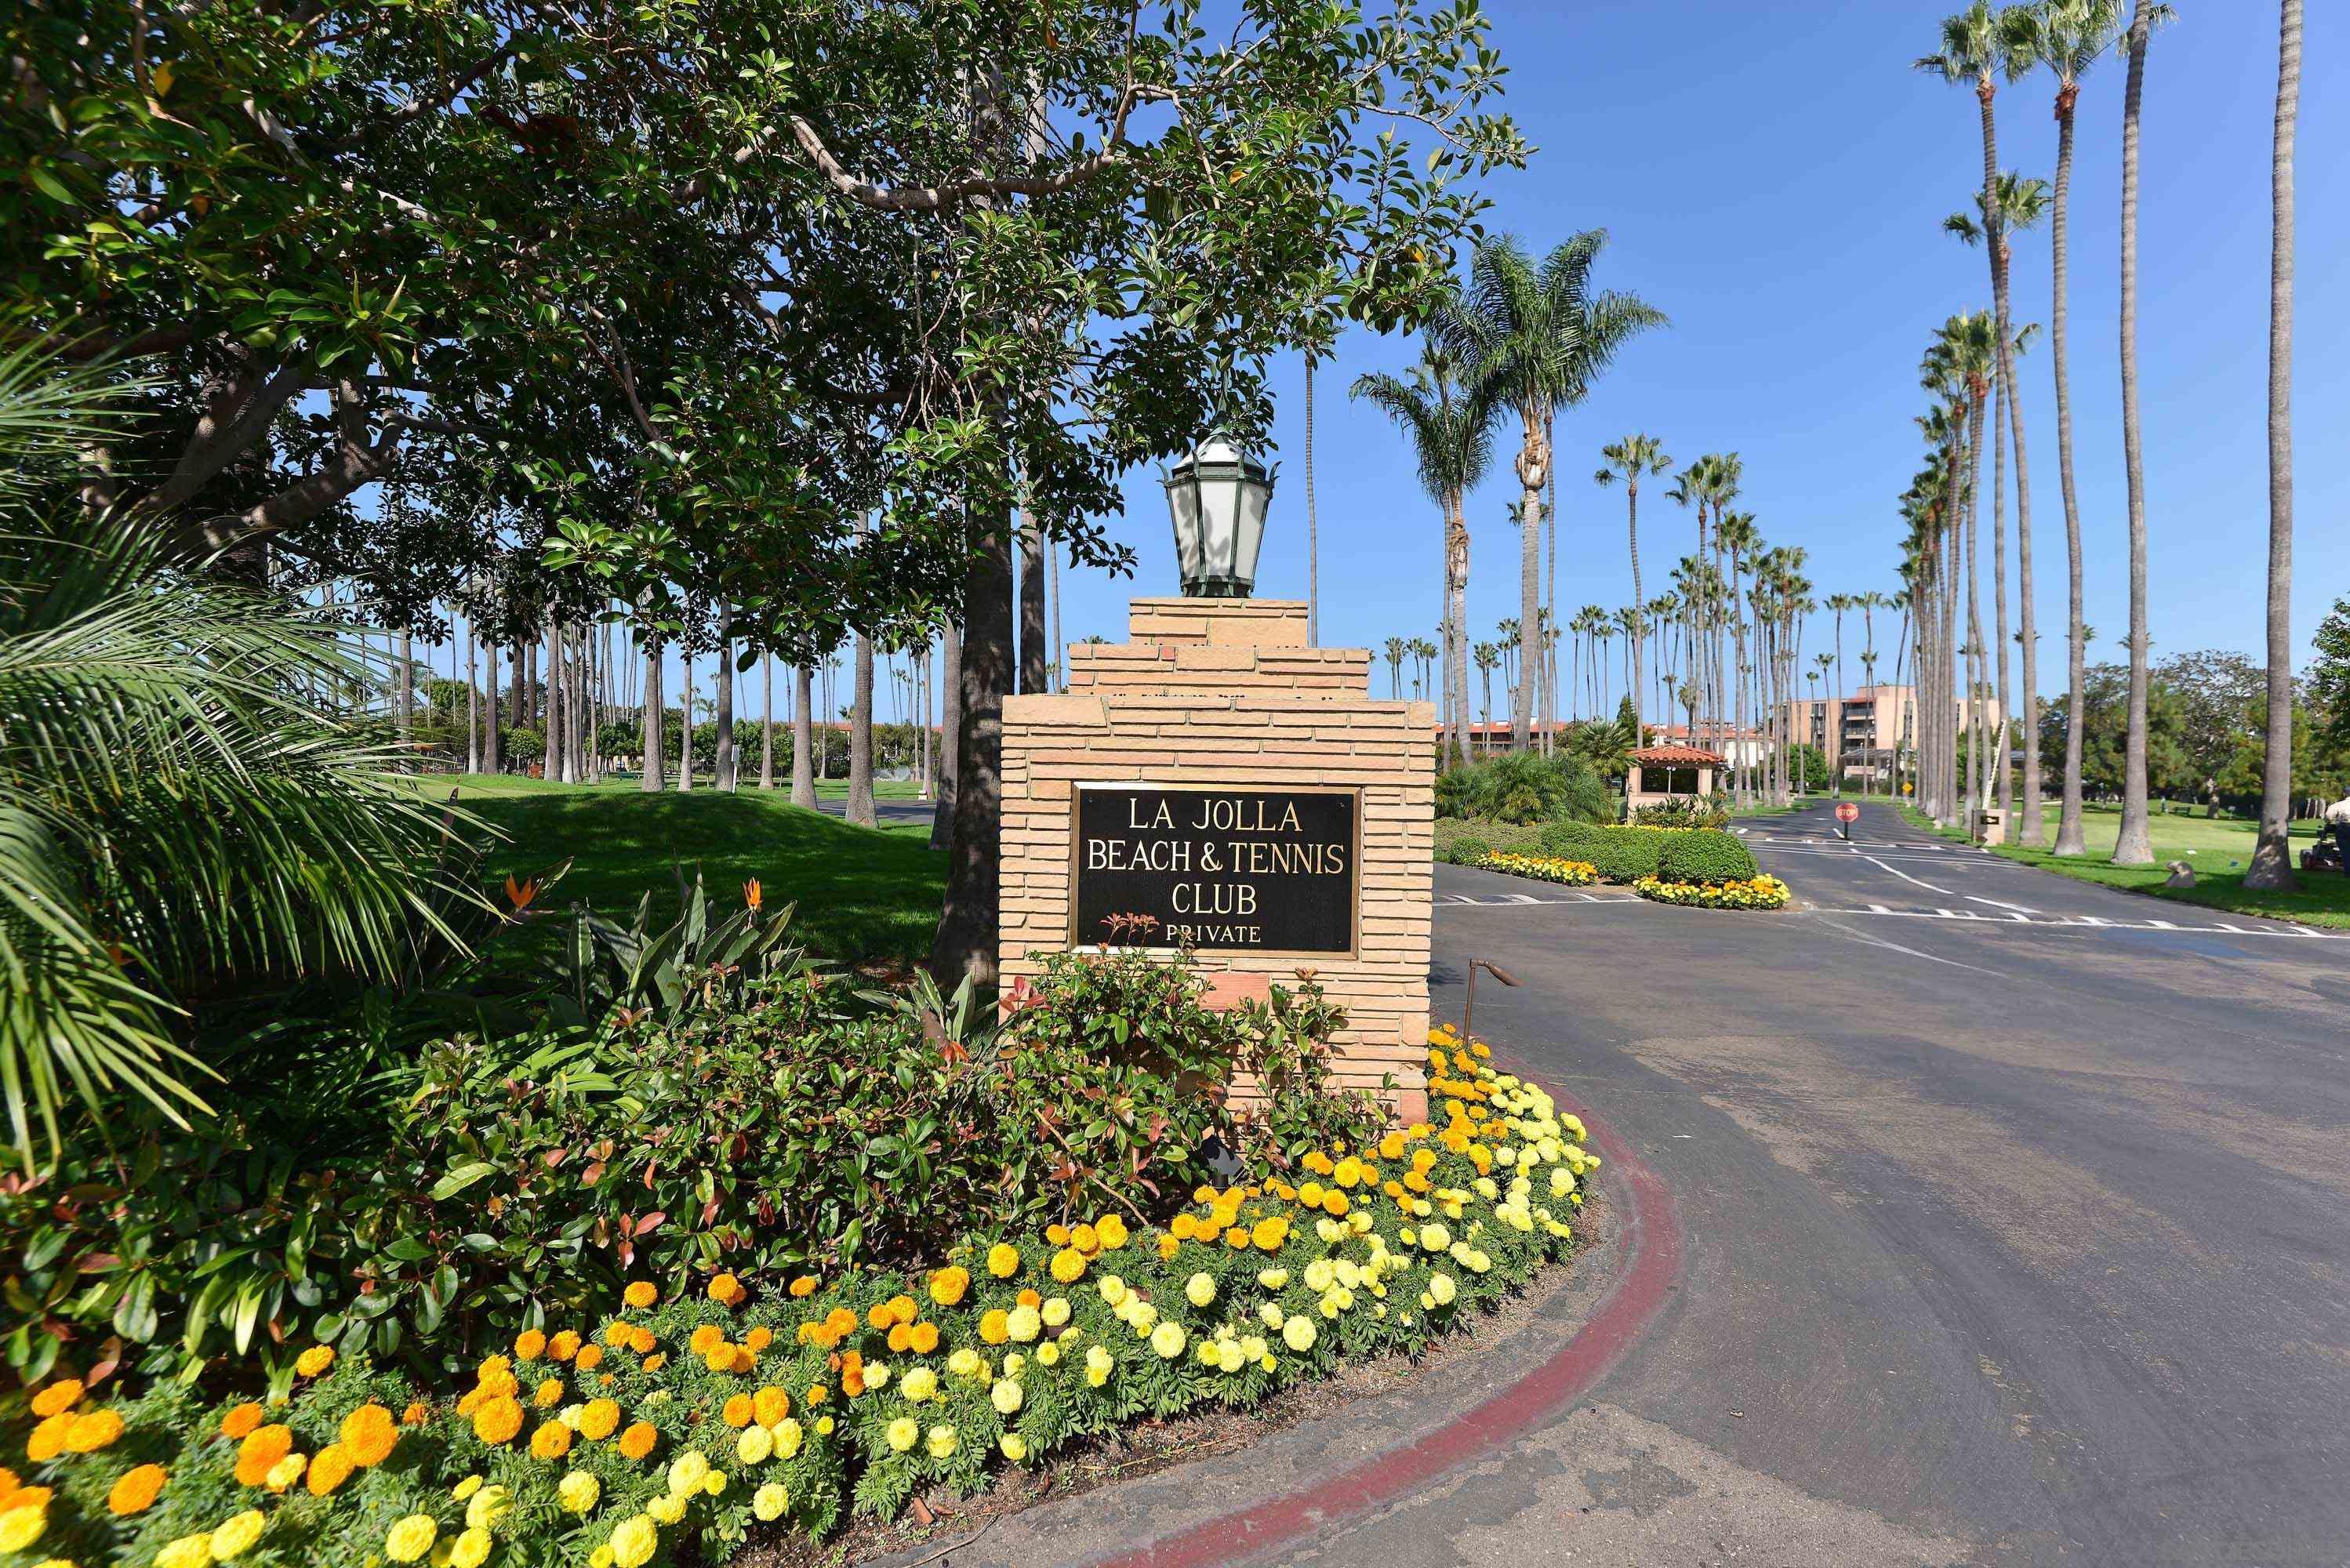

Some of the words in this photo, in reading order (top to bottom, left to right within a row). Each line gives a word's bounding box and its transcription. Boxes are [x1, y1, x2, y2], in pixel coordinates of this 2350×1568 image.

[1128, 797, 1176, 829] LA
[1191, 798, 1303, 832] JOLLA
[1087, 839, 1192, 872] BEACH
[1200, 841, 1223, 872] &
[1228, 841, 1344, 874] TENNIS
[1171, 883, 1257, 915] CLUB
[1166, 924, 1261, 943] PRIVATE
